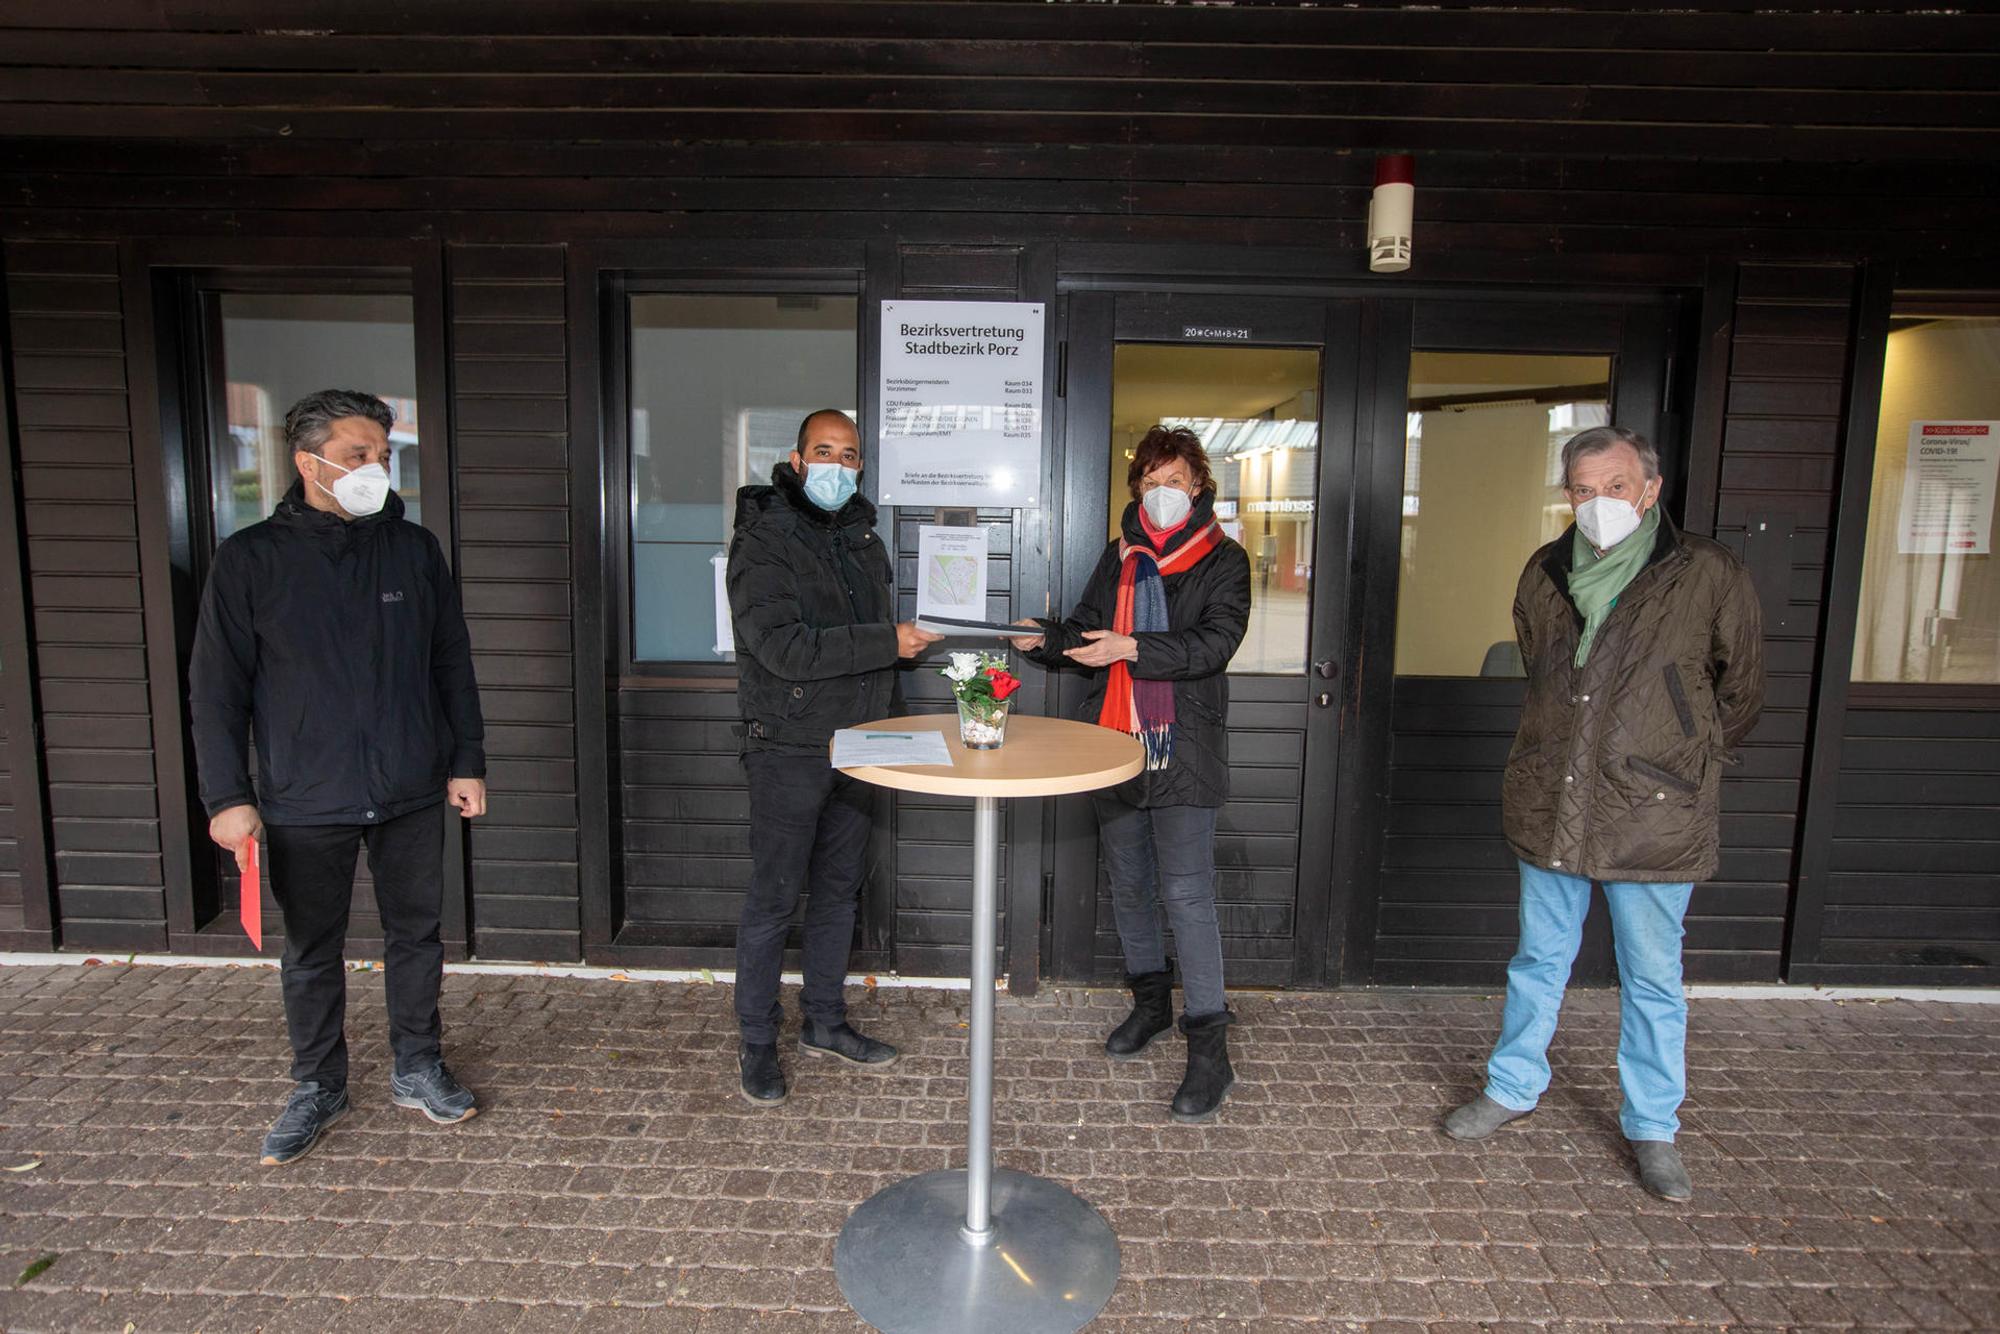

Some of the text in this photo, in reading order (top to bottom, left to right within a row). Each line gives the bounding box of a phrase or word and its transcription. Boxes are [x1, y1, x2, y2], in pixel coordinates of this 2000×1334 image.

[900, 323, 1025, 342] Bezirksvertretung
[905, 341, 1019, 356] Stadtbezirk Porz
[886, 378, 950, 386] Bezirksbürgermeisterin
